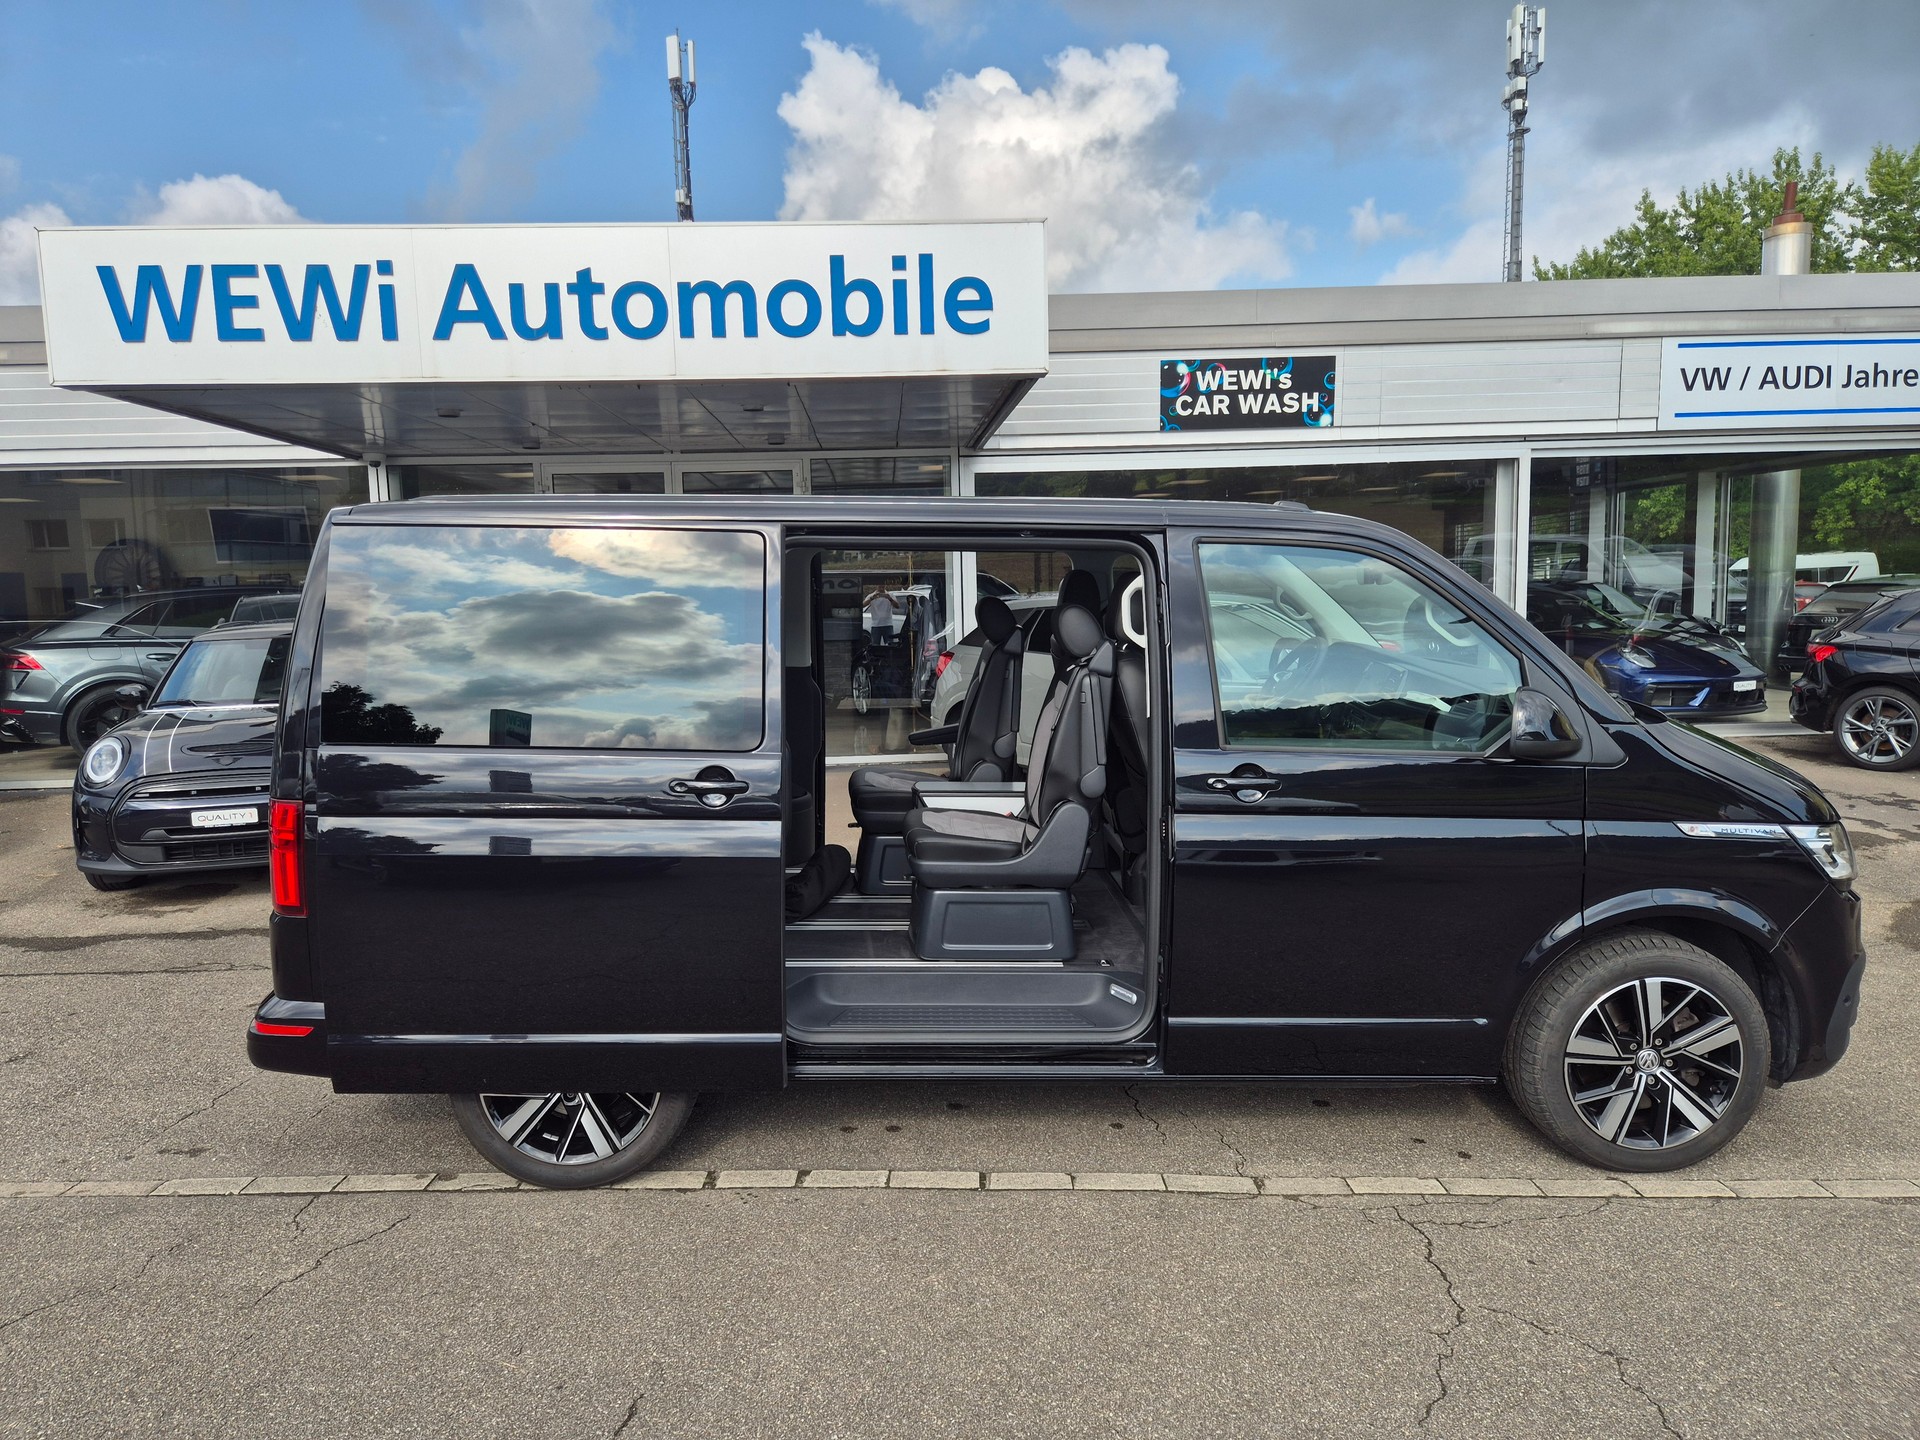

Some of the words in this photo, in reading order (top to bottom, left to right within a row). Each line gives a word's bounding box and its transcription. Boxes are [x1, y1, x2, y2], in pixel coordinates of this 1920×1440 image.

[96, 259, 398, 343] WEWi
[433, 253, 994, 342] Automobile
[1196, 367, 1292, 391] WEWi's
[1680, 366, 1732, 392] VW
[1758, 364, 1832, 390] AUDI
[1841, 362, 1919, 389] Jahre
[1175, 394, 1230, 416] CAR
[1238, 392, 1319, 415] WASH
[197, 812, 246, 822] QUALITY
[1720, 827, 1777, 835] MULTIVAN
